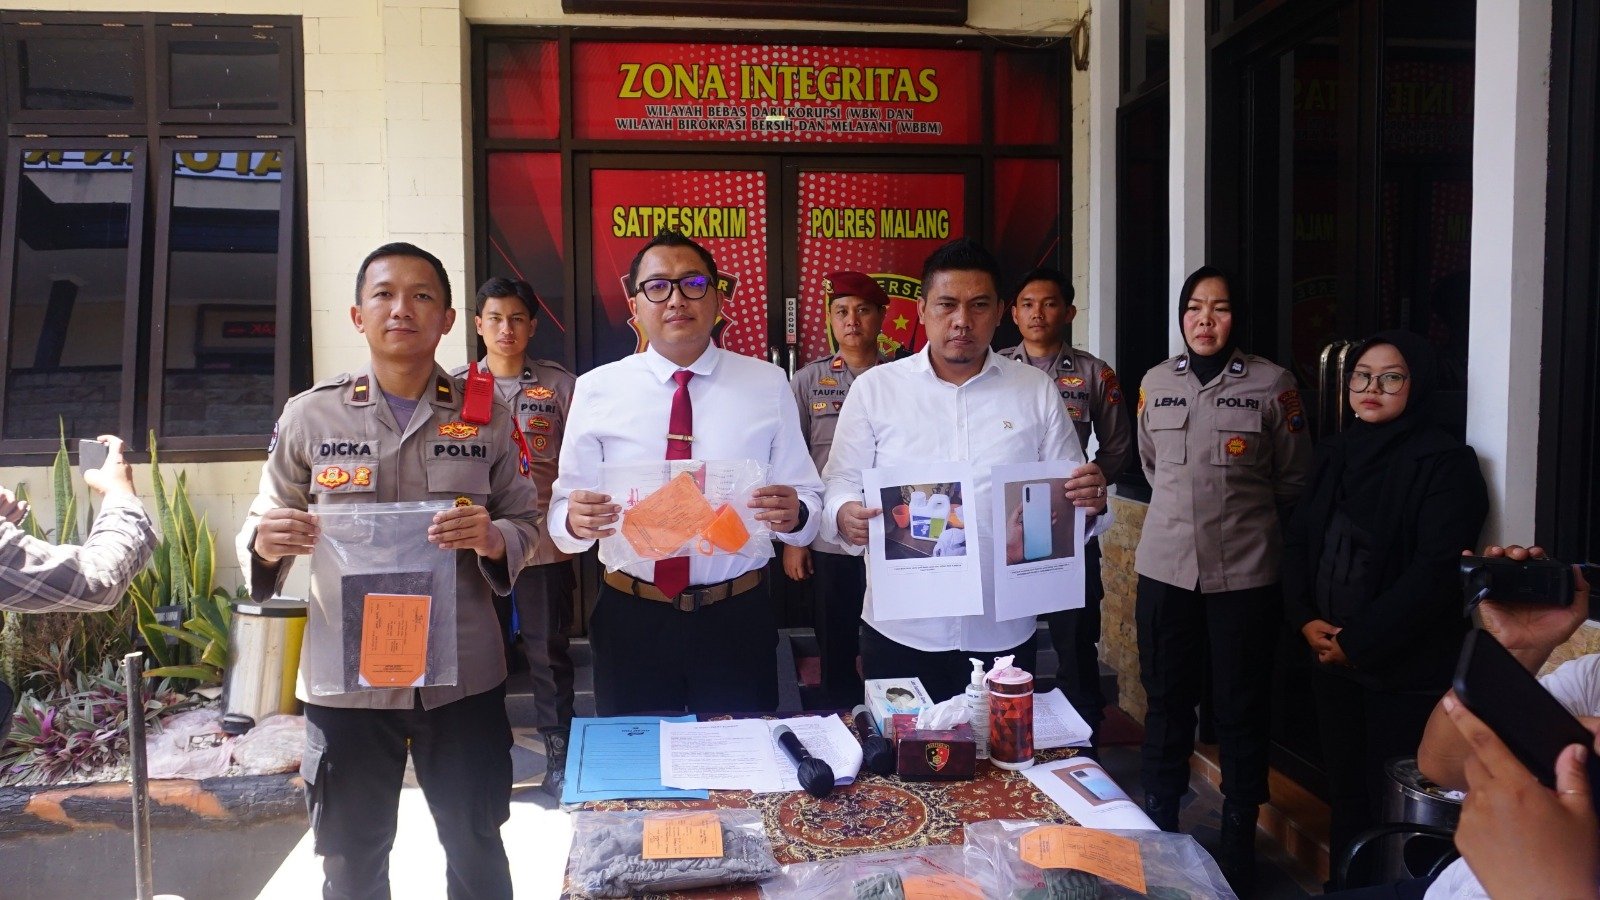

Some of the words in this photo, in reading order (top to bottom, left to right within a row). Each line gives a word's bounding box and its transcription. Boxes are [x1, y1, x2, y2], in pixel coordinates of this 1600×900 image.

[618, 62, 729, 100] ZONA
[740, 65, 939, 103] INTEGRITAS
[646, 105, 703, 117] WILAYAH
[708, 106, 747, 118] BEBAS
[751, 106, 783, 118] DARI
[787, 107, 841, 119] KORUPSI
[846, 108, 882, 120] (WBK)
[887, 108, 914, 120] DAN
[615, 118, 673, 130] WILAYAH
[677, 119, 747, 131] BIROKRASI
[751, 119, 794, 132] BERSIH
[800, 121, 828, 132] DAN
[831, 121, 892, 133] MELAYANI
[896, 122, 943, 135] (WBBM)
[612, 206, 746, 238] SATRESKRIM
[811, 208, 877, 239] POLRES
[880, 209, 950, 239] MALANG
[787, 301, 795, 334] DORONG
[812, 389, 846, 397] TAUFIK
[1060, 391, 1090, 401] OLRI
[521, 403, 556, 414] POLRI
[1154, 397, 1187, 408] LEHA
[1216, 397, 1260, 410] POLRI
[319, 442, 372, 457] DICKA
[434, 444, 487, 459] POLRI
